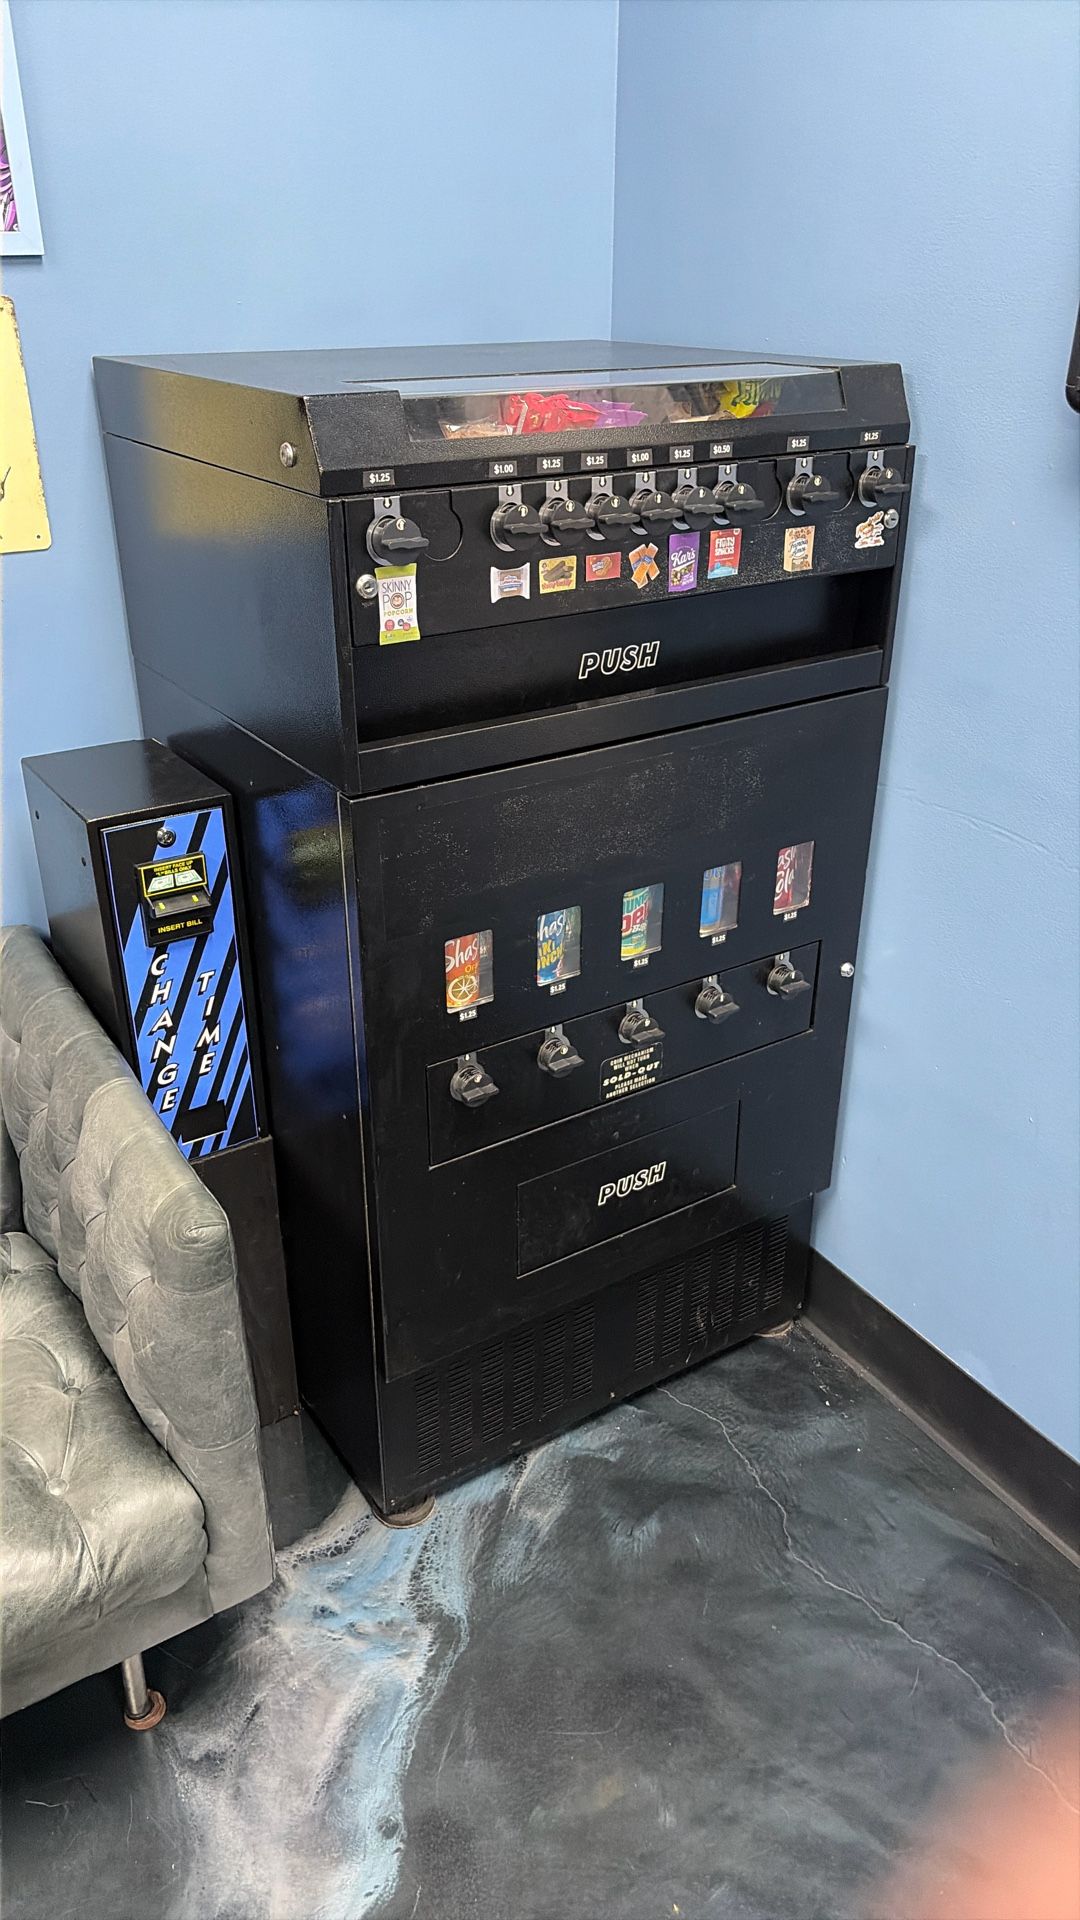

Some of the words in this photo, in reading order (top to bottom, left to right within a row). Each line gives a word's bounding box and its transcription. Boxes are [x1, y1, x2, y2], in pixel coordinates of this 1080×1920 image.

[864, 431, 879, 441] $1.25
[791, 438, 807, 448] $1.25
[674, 449, 691, 459] $1.25
[713, 445, 730, 455] $0.50
[542, 458, 561, 469] $1.25
[586, 455, 604, 466] $1.25
[631, 452, 649, 463] $1.00
[493, 463, 514, 475] $1.00
[369, 472, 391, 484] $1.25
[671, 548, 696, 567] Kar's
[382, 580, 412, 593] SKINNY
[383, 608, 414, 617] POPCORN
[578, 641, 660, 680] PUSH
[154, 864, 172, 873] INSERT
[783, 911, 797, 921] $1.25
[157, 922, 185, 934] INSERT
[186, 919, 203, 927] BILL
[711, 934, 726, 944] $1.25
[444, 938, 479, 973] Shas
[633, 957, 649, 968] $1.25
[550, 982, 566, 994] $1.25
[196, 970, 221, 1074] TIME
[459, 1010, 477, 1022] $1.25
[150, 953, 180, 1113] CHANGE
[610, 1057, 623, 1066] COIN
[623, 1047, 654, 1062] MECHANISM
[613, 1062, 626, 1070] WILL
[637, 1053, 650, 1062] TURN
[624, 1063, 639, 1072] WHEN
[602, 1061, 660, 1087] SOLD-OUT
[605, 1087, 629, 1099] ANOTHER
[629, 1076, 656, 1091] SELECTION
[614, 1079, 633, 1090] PLEASE
[633, 1074, 648, 1083] MAKE
[597, 1161, 667, 1207] PUSH
